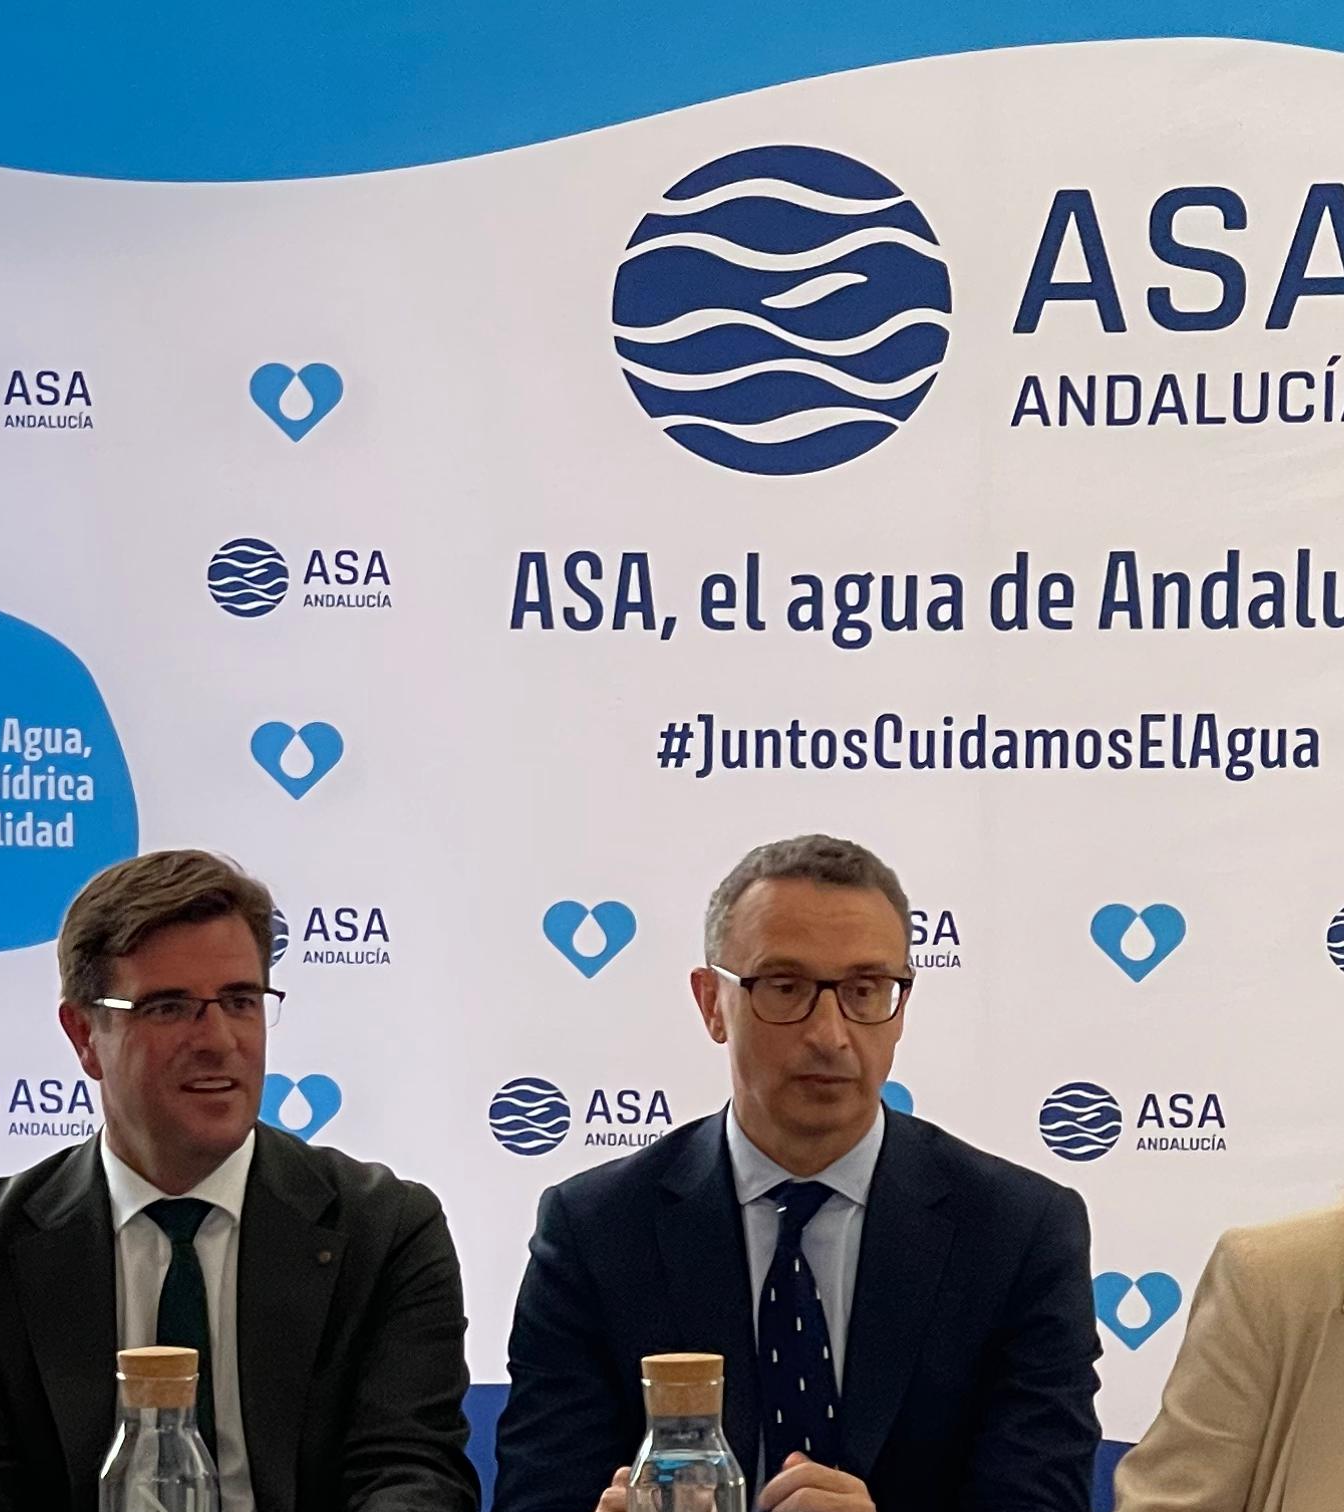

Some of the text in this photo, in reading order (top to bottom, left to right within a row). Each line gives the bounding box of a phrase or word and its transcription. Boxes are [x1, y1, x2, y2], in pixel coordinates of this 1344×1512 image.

[5, 370, 92, 407] ASA
[5, 411, 94, 430] ANDALUCÍA
[303, 550, 391, 586] ASA
[303, 590, 392, 609] ANDALUCÍA
[510, 549, 677, 641] ASA,
[699, 551, 764, 631] el
[787, 565, 964, 650] agua
[989, 551, 1075, 631] de
[1, 717, 92, 763] Agua,
[656, 712, 1321, 782] #JuntosCuidamosElAgua
[303, 908, 390, 942] ASA
[909, 910, 960, 946] SA
[303, 946, 391, 965] ANDALUCÍA
[908, 950, 961, 968] LUCÍA
[9, 1079, 94, 1114] ASA
[585, 1089, 672, 1125] ASA
[1137, 1094, 1226, 1129] ASA
[8, 1119, 95, 1138] ANDALUCÍA
[584, 1130, 664, 1147] ANDALUC
[1136, 1134, 1227, 1152] ANDALUCÍA
